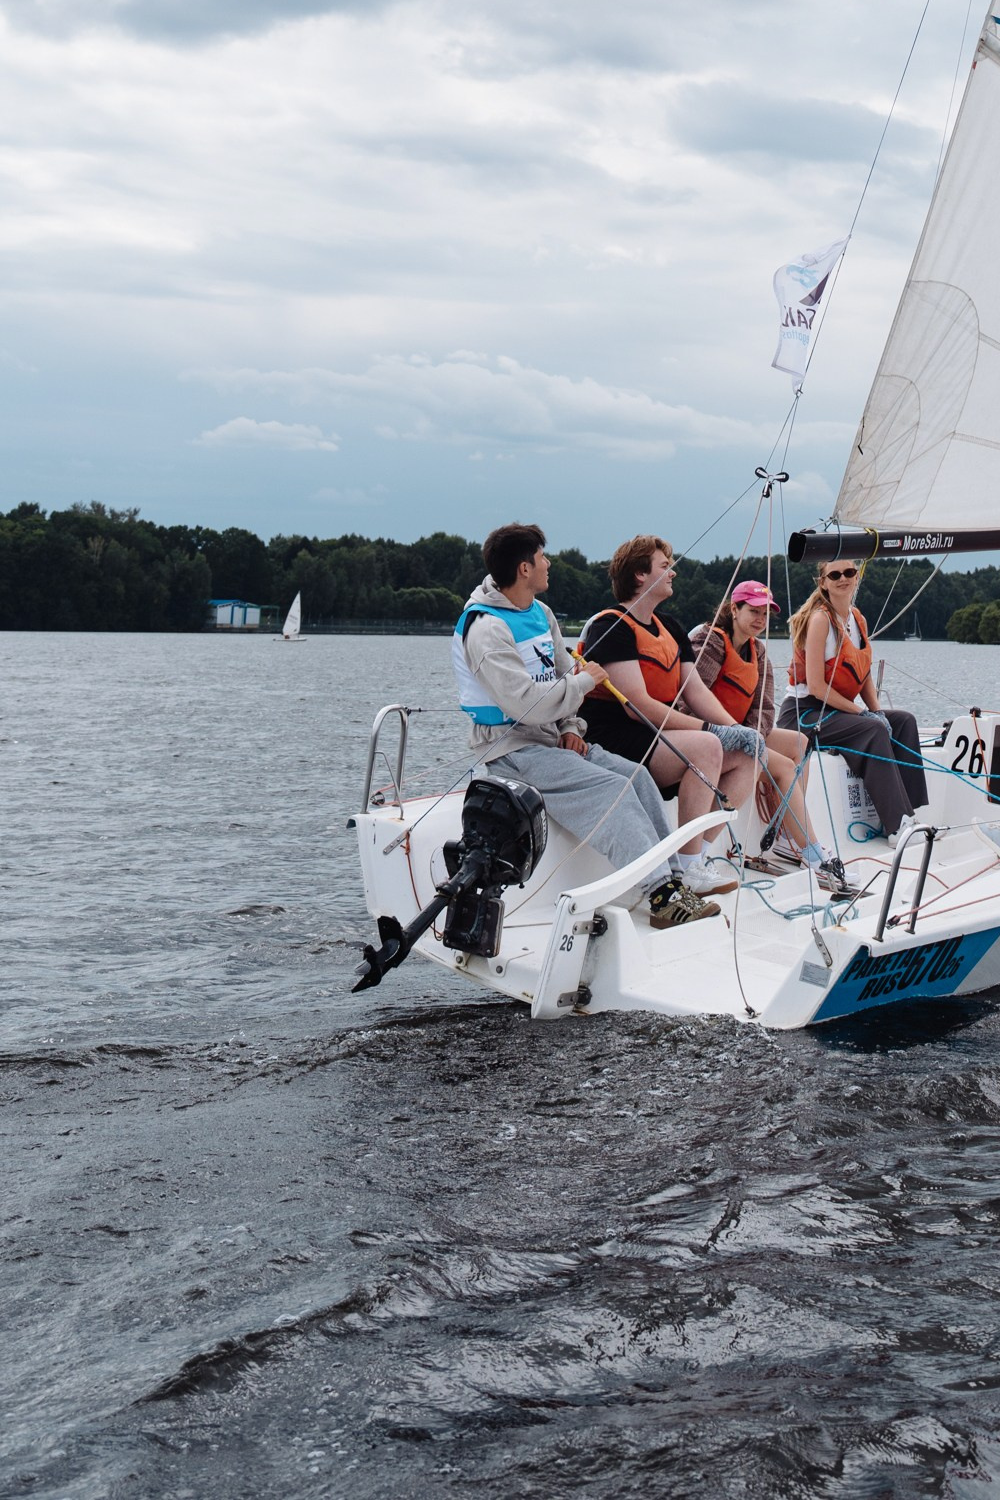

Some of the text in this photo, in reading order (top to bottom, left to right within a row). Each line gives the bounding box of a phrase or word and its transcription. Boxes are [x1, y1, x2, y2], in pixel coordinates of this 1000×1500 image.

[902, 533, 954, 551] MoreSail.ru
[951, 734, 986, 779] 26
[559, 934, 575, 952] 26
[940, 955, 965, 981] 26
[857, 972, 902, 1001] RUS
